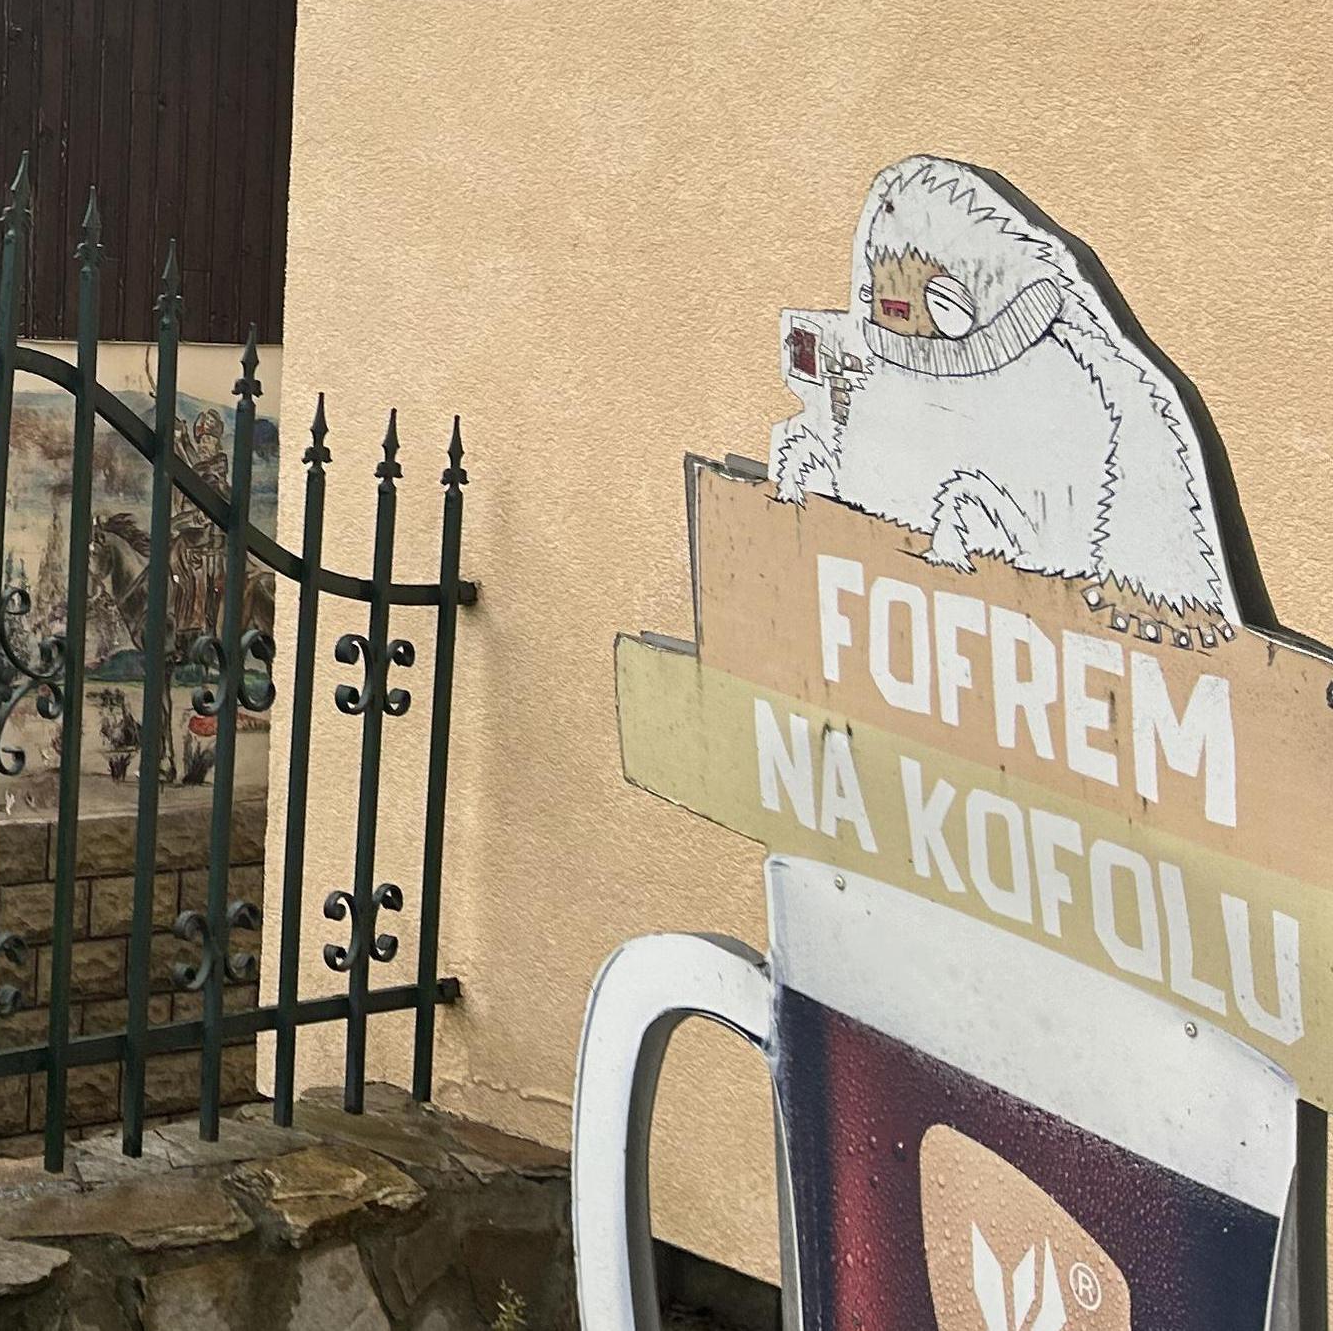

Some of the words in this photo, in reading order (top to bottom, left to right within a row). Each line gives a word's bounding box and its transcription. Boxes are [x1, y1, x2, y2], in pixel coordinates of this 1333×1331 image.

[816, 554, 1237, 827] FOFREM
[754, 697, 878, 853] NA
[900, 755, 1305, 1046] KOFOLU
